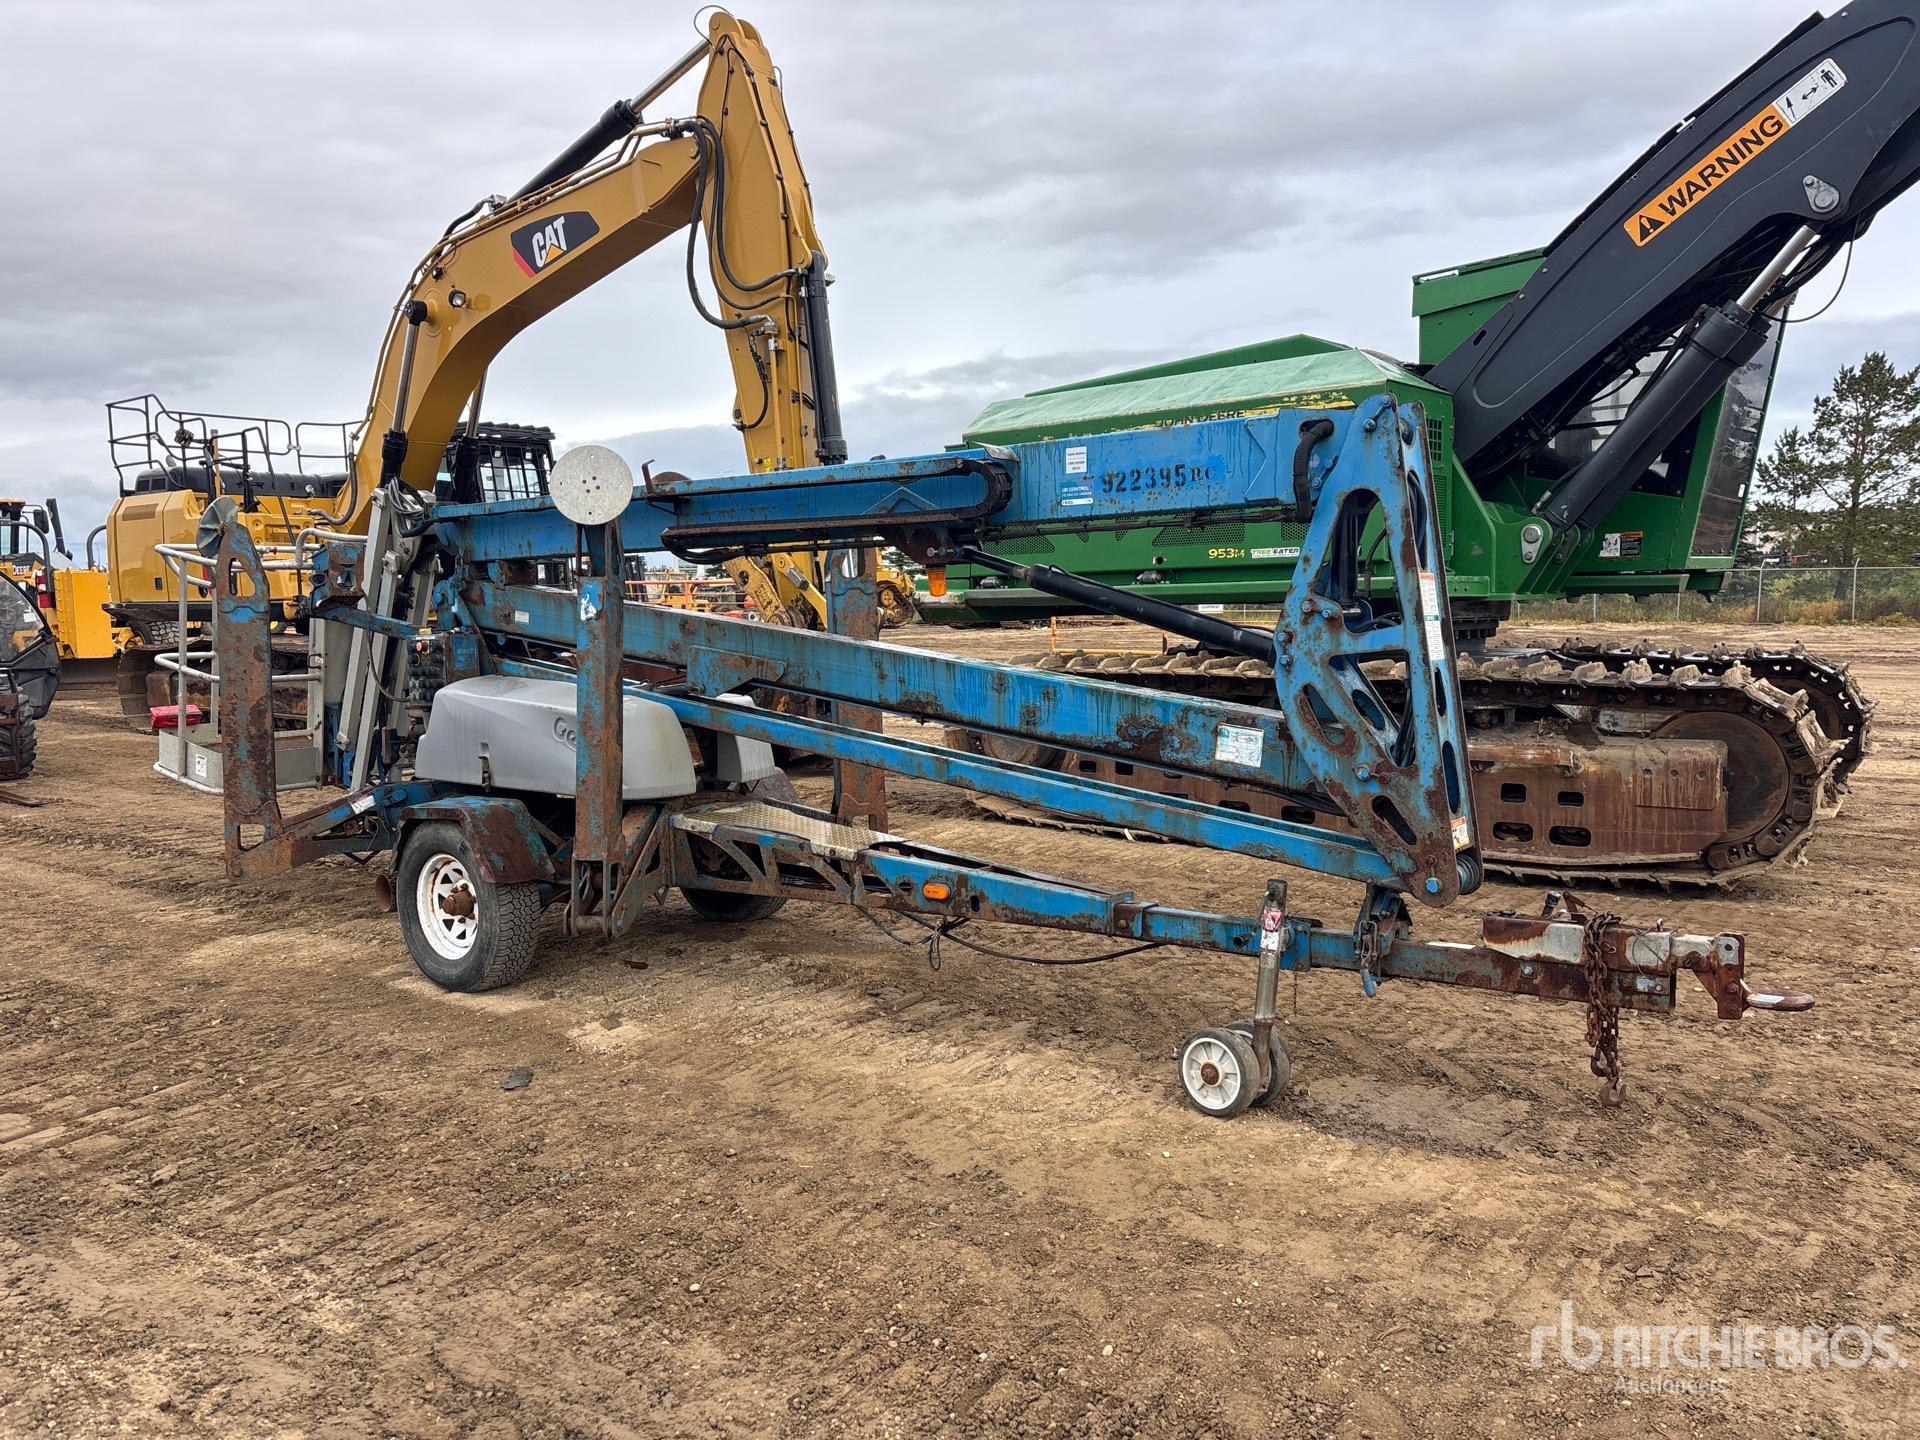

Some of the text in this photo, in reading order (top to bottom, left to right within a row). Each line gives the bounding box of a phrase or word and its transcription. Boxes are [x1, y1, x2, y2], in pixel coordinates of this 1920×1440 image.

[1658, 114, 1784, 217] WARNING
[532, 215, 567, 268] CAT
[1208, 548, 1245, 559] 953M
